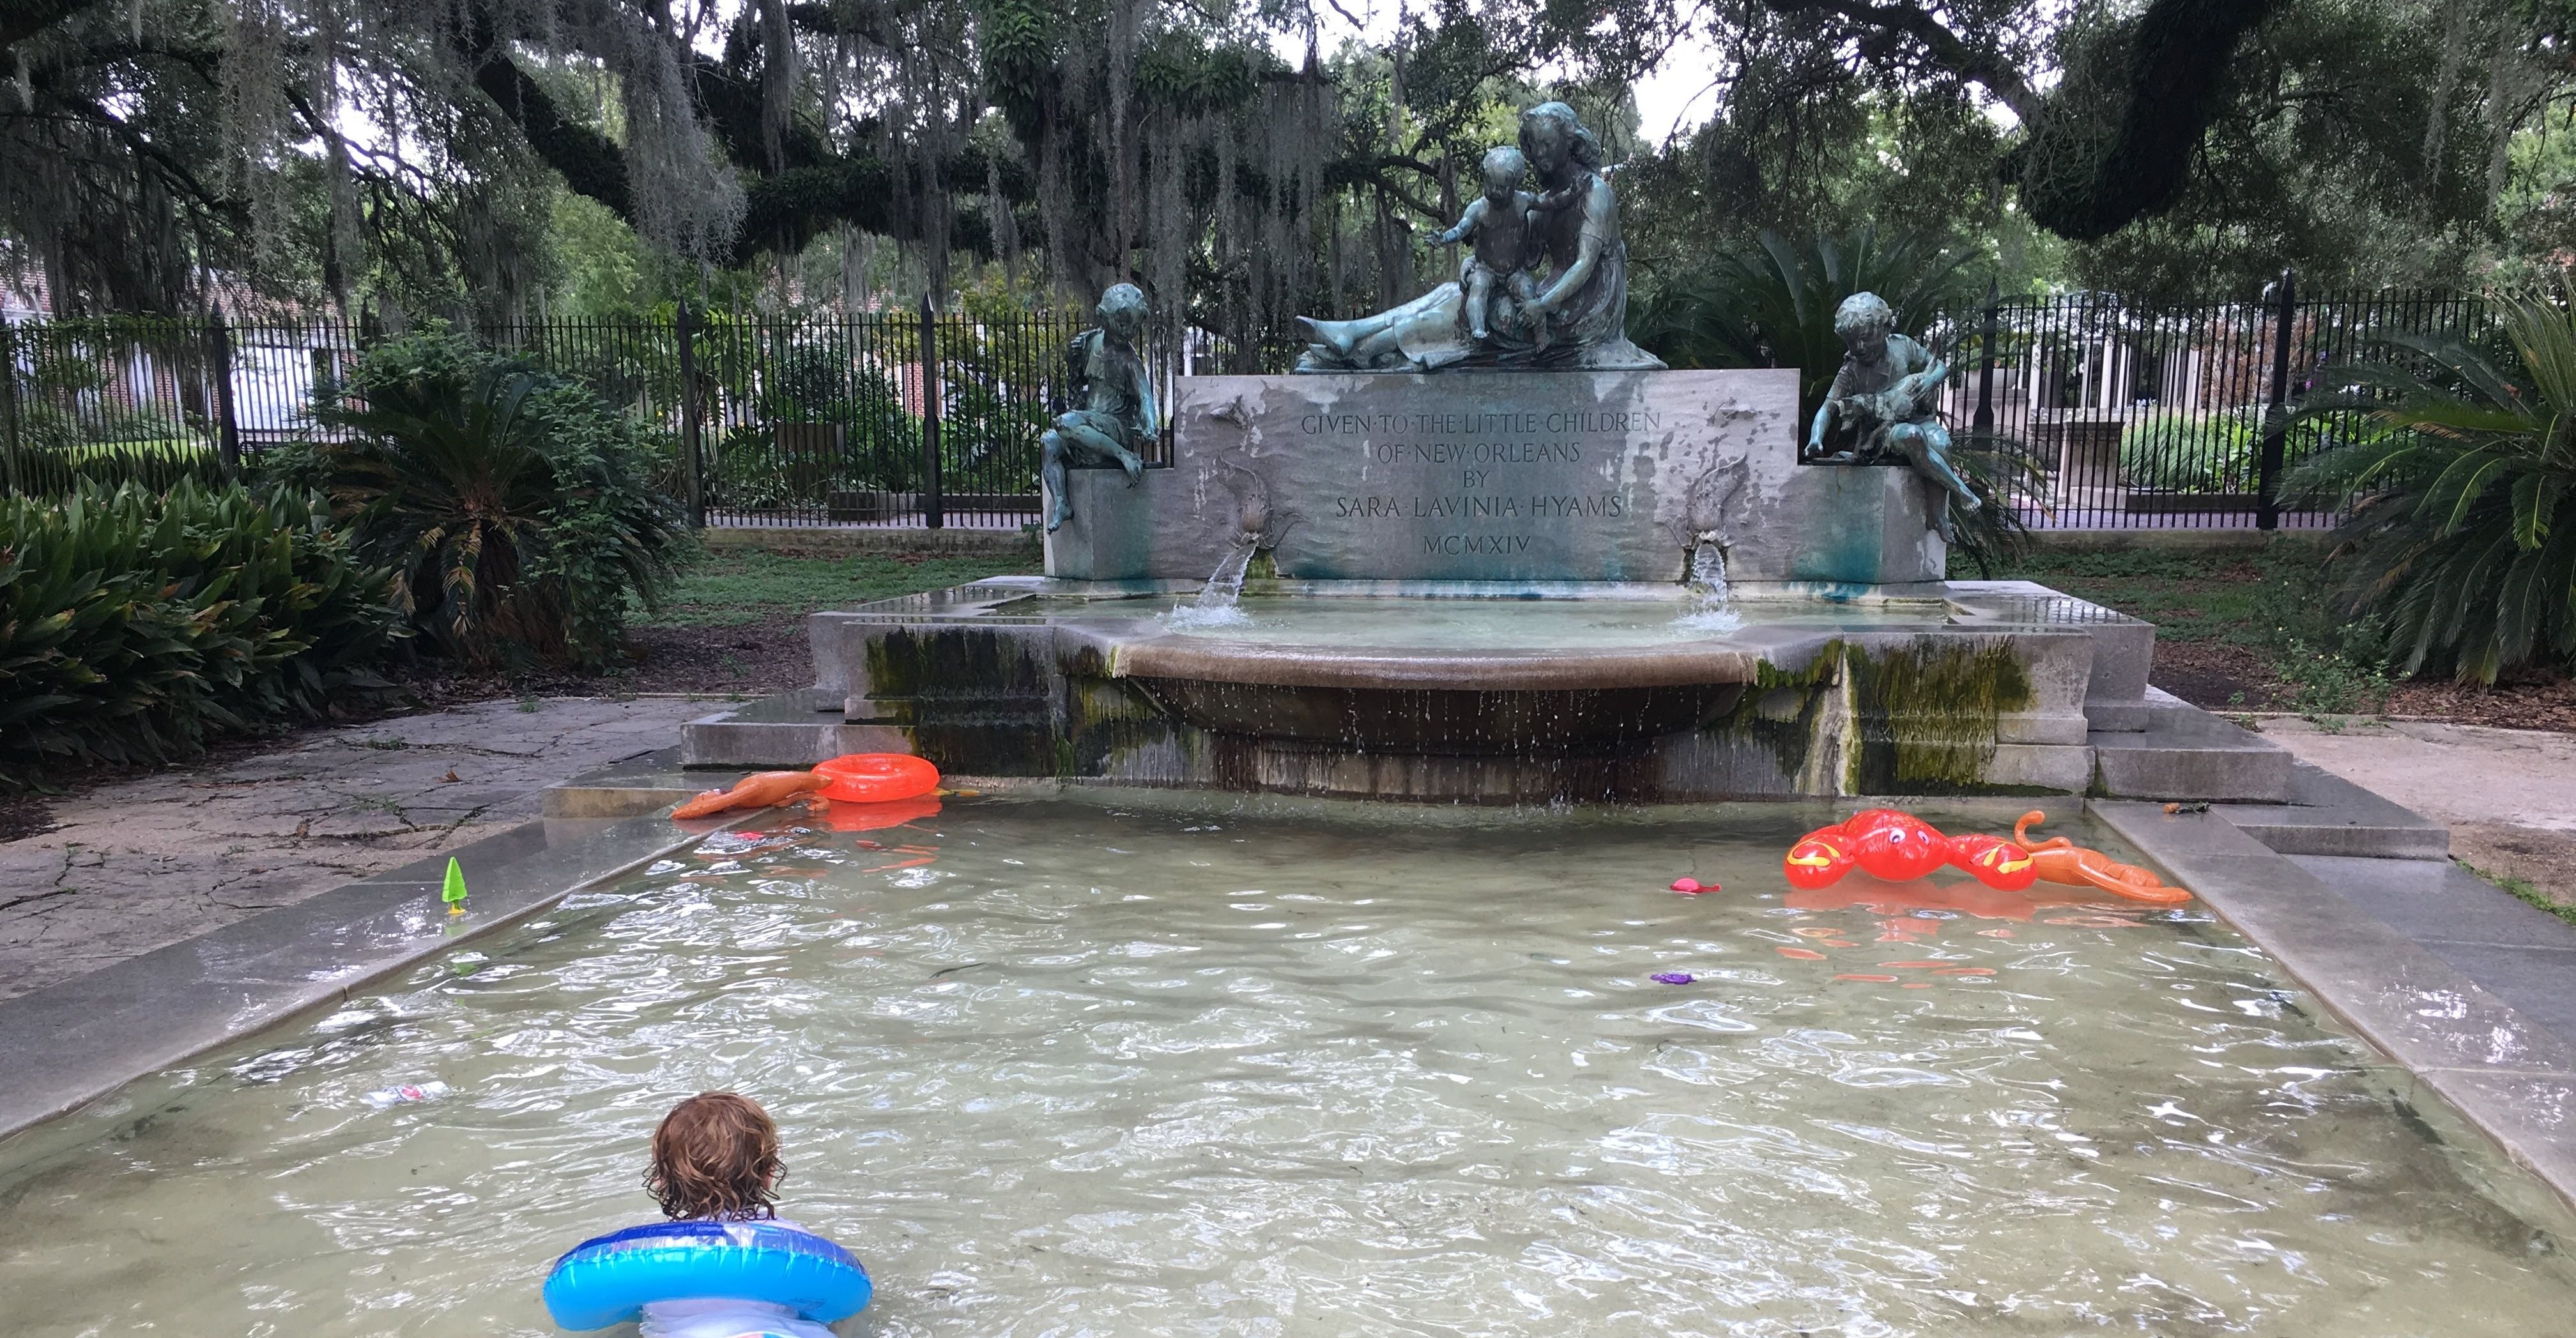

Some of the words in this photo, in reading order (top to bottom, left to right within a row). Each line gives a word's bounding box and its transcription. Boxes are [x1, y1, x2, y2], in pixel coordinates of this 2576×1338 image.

[1301, 414, 1371, 435] GIVEN
[1378, 414, 1408, 435] TO
[1416, 414, 1457, 434] THE
[1465, 413, 1537, 434] LITTLE
[1546, 412, 1660, 434] CHILDREN
[1377, 444, 1406, 464] OF
[1415, 443, 1467, 464] NEW
[1474, 442, 1581, 464] ORLEANS
[1463, 470, 1491, 488] BY
[1336, 496, 1402, 518] SARA
[1414, 496, 1519, 517] LAVINIA
[1531, 495, 1621, 517] HYAMS
[1423, 535, 1531, 555] MCMXIV
